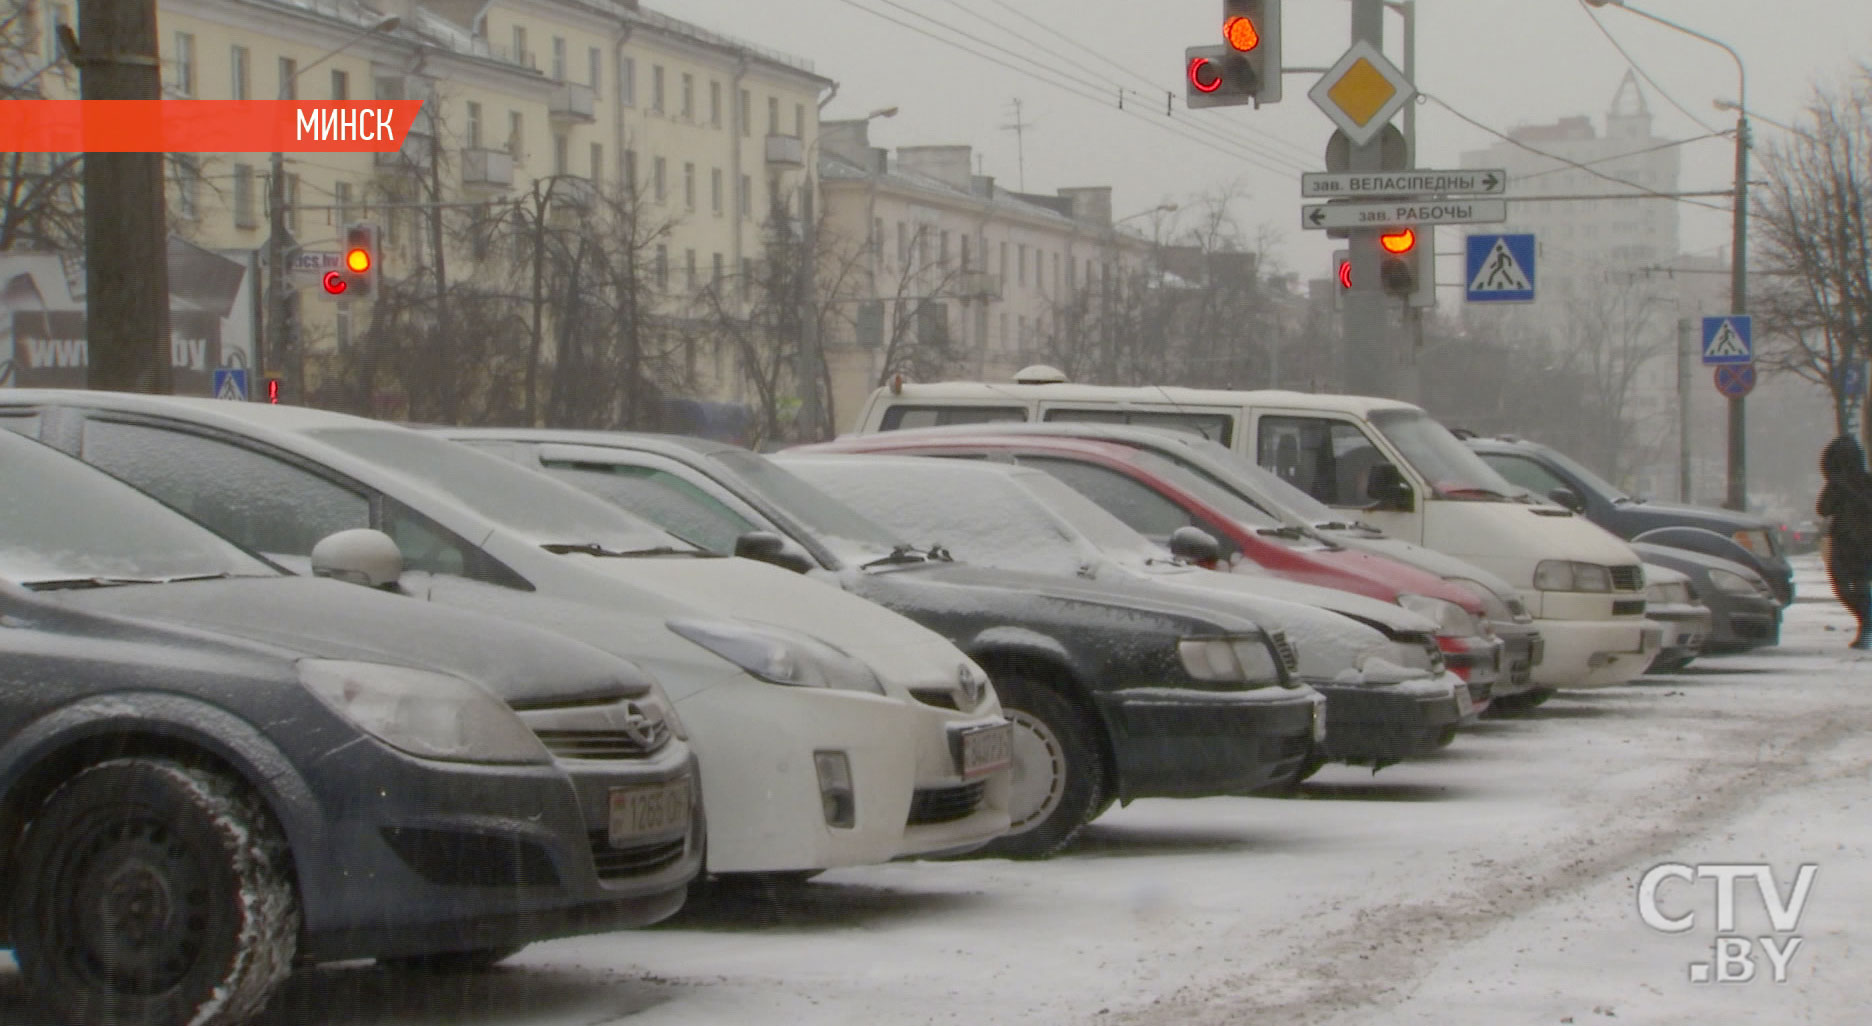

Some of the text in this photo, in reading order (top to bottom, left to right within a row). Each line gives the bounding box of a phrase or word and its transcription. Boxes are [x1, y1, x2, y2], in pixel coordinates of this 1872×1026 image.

[1313, 176, 1475, 191] зав. ВЕЛАСІПЕДНЫ
[1359, 206, 1473, 222] зав. РАБОЧЫ
